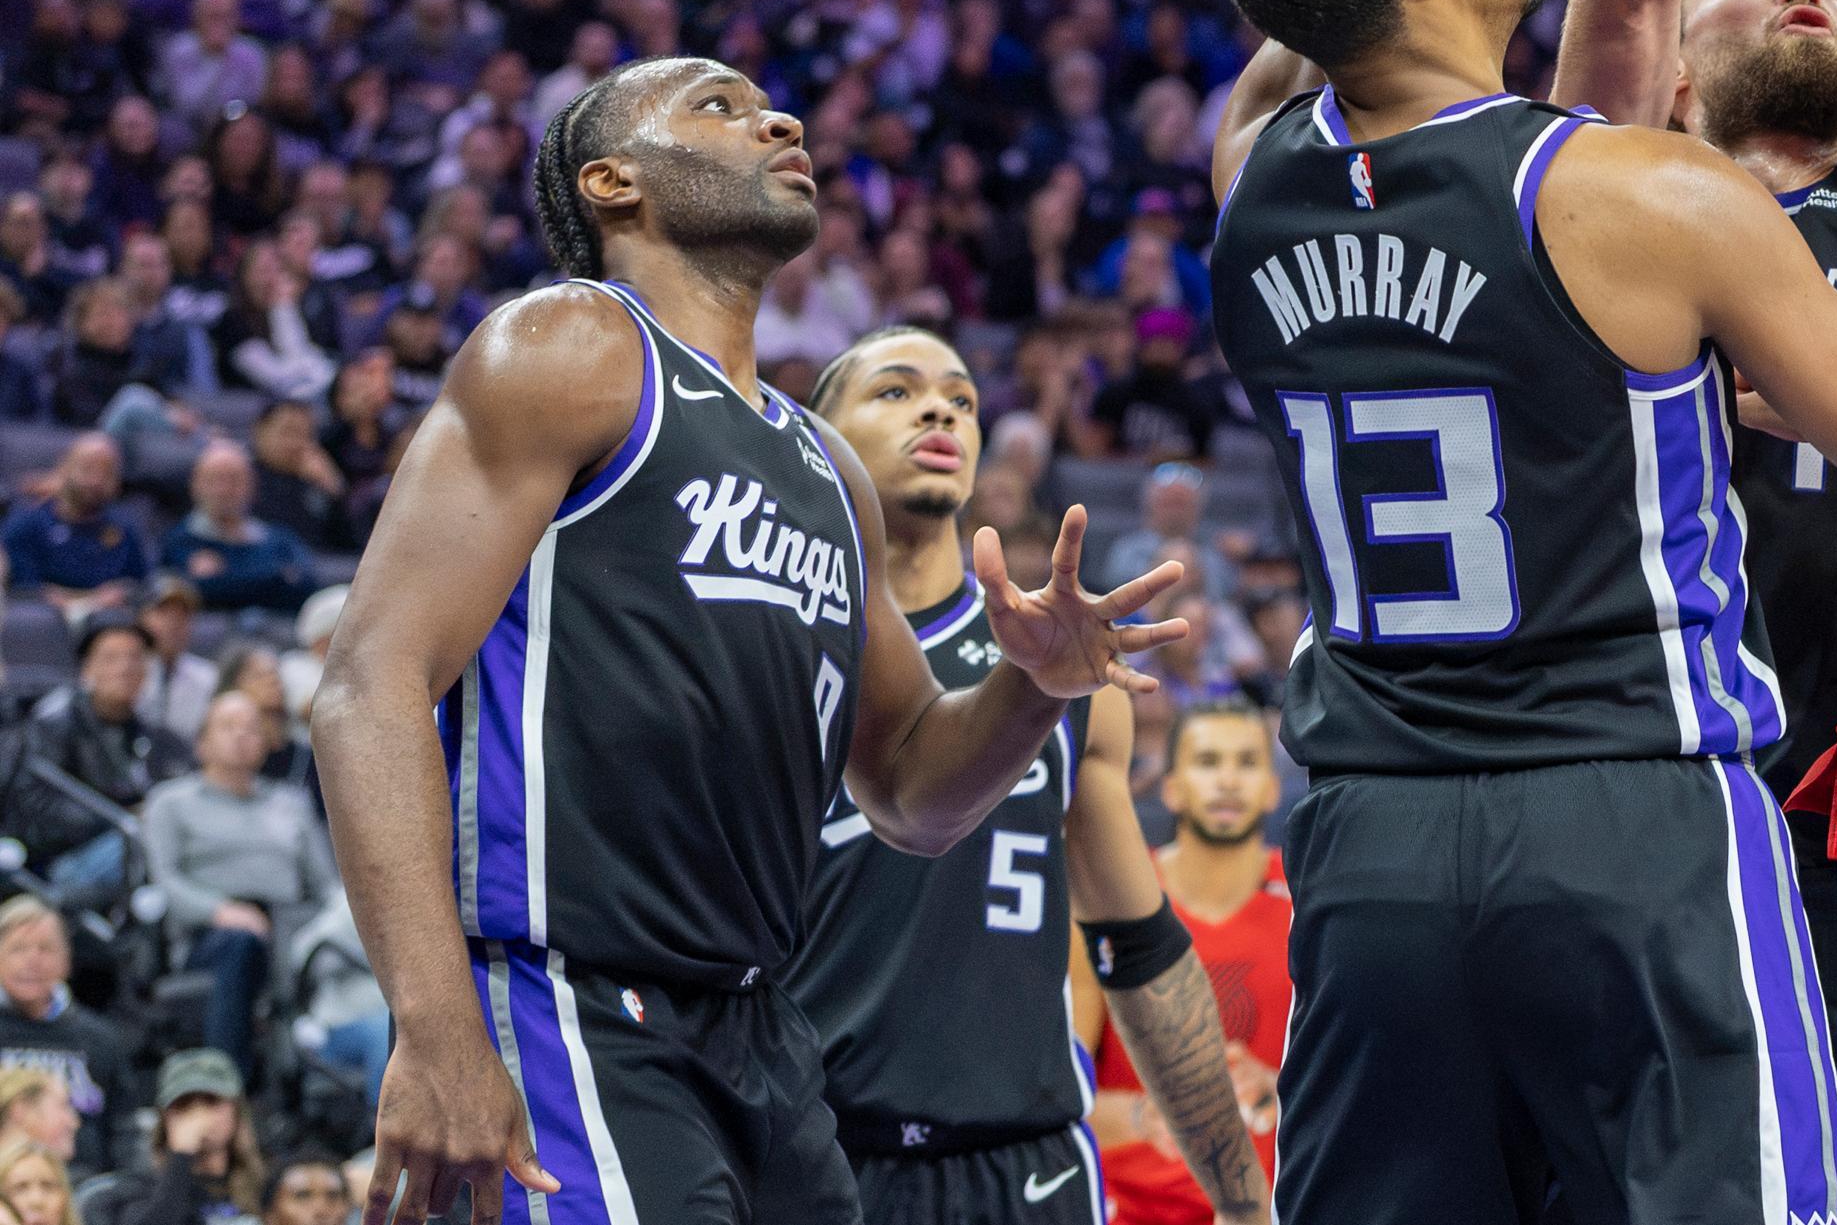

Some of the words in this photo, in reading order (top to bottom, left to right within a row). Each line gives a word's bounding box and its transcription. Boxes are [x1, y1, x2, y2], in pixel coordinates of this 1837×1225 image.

[1251, 233, 1487, 345] MURRAY
[673, 472, 851, 625] Kings
[1275, 386, 1521, 644] 13
[985, 826, 1050, 934] 5
